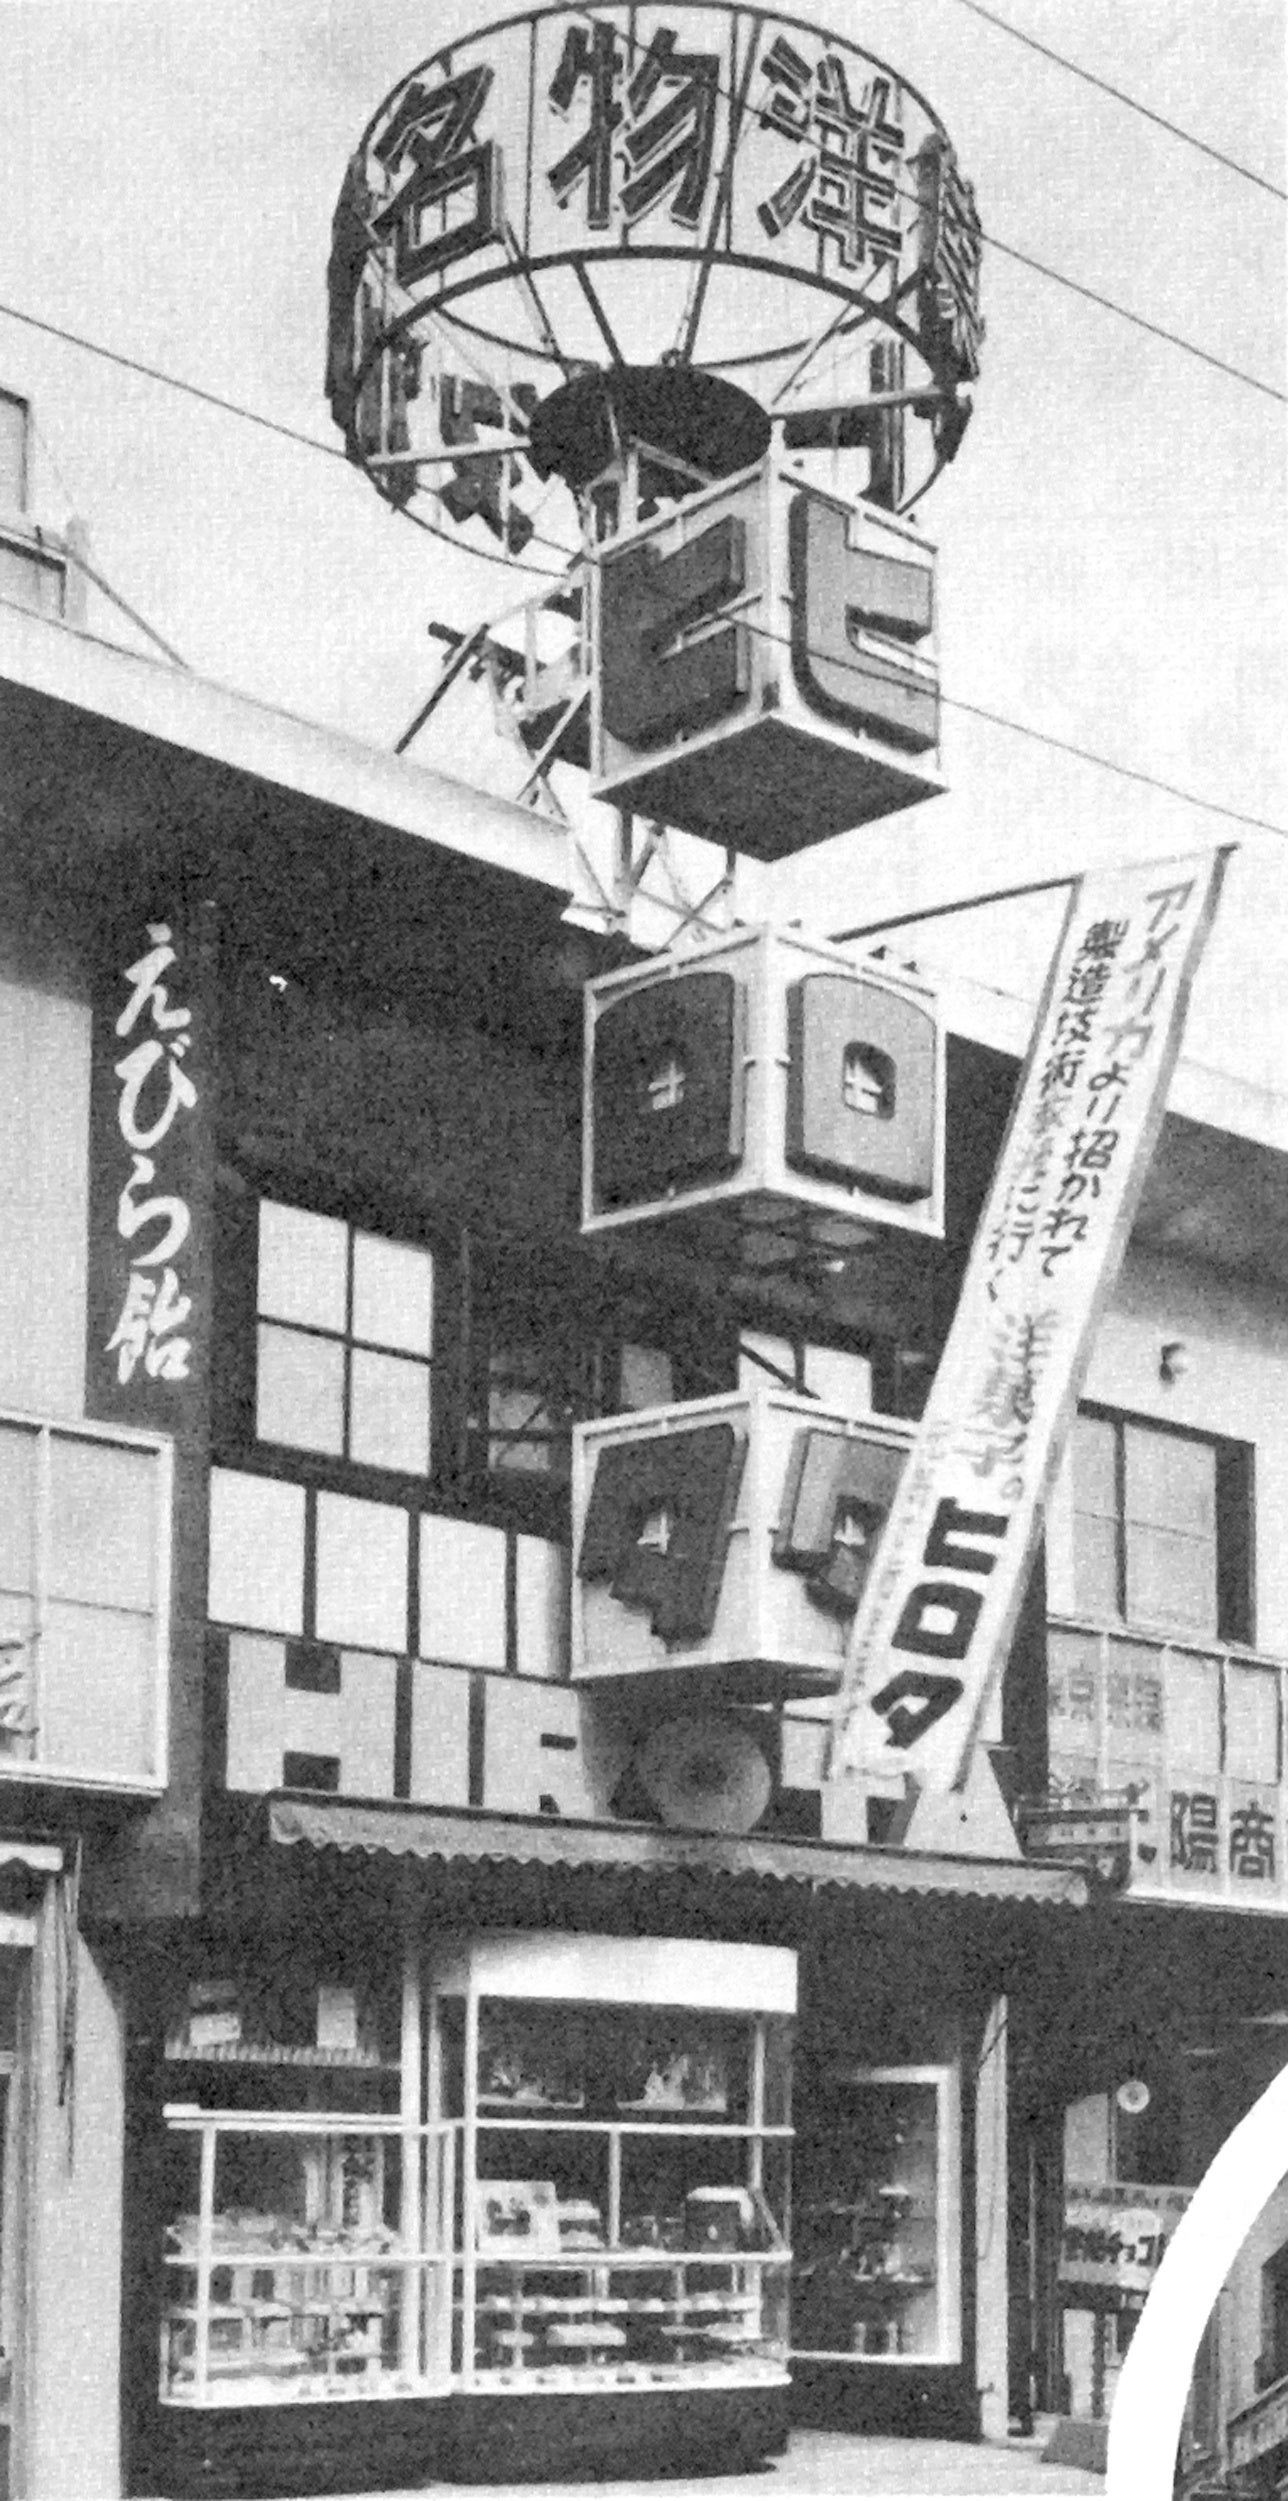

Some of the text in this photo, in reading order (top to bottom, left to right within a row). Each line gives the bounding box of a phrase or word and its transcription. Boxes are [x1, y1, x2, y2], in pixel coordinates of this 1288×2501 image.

[103, 922, 198, 1385] えびら飴
[1039, 879, 1196, 1278] アメリカより招かれて
[223, 1632, 1023, 1859] HIRTA
[869, 1495, 1010, 1750] ヒロタ
[1134, 1789, 1276, 1883] 陽商
